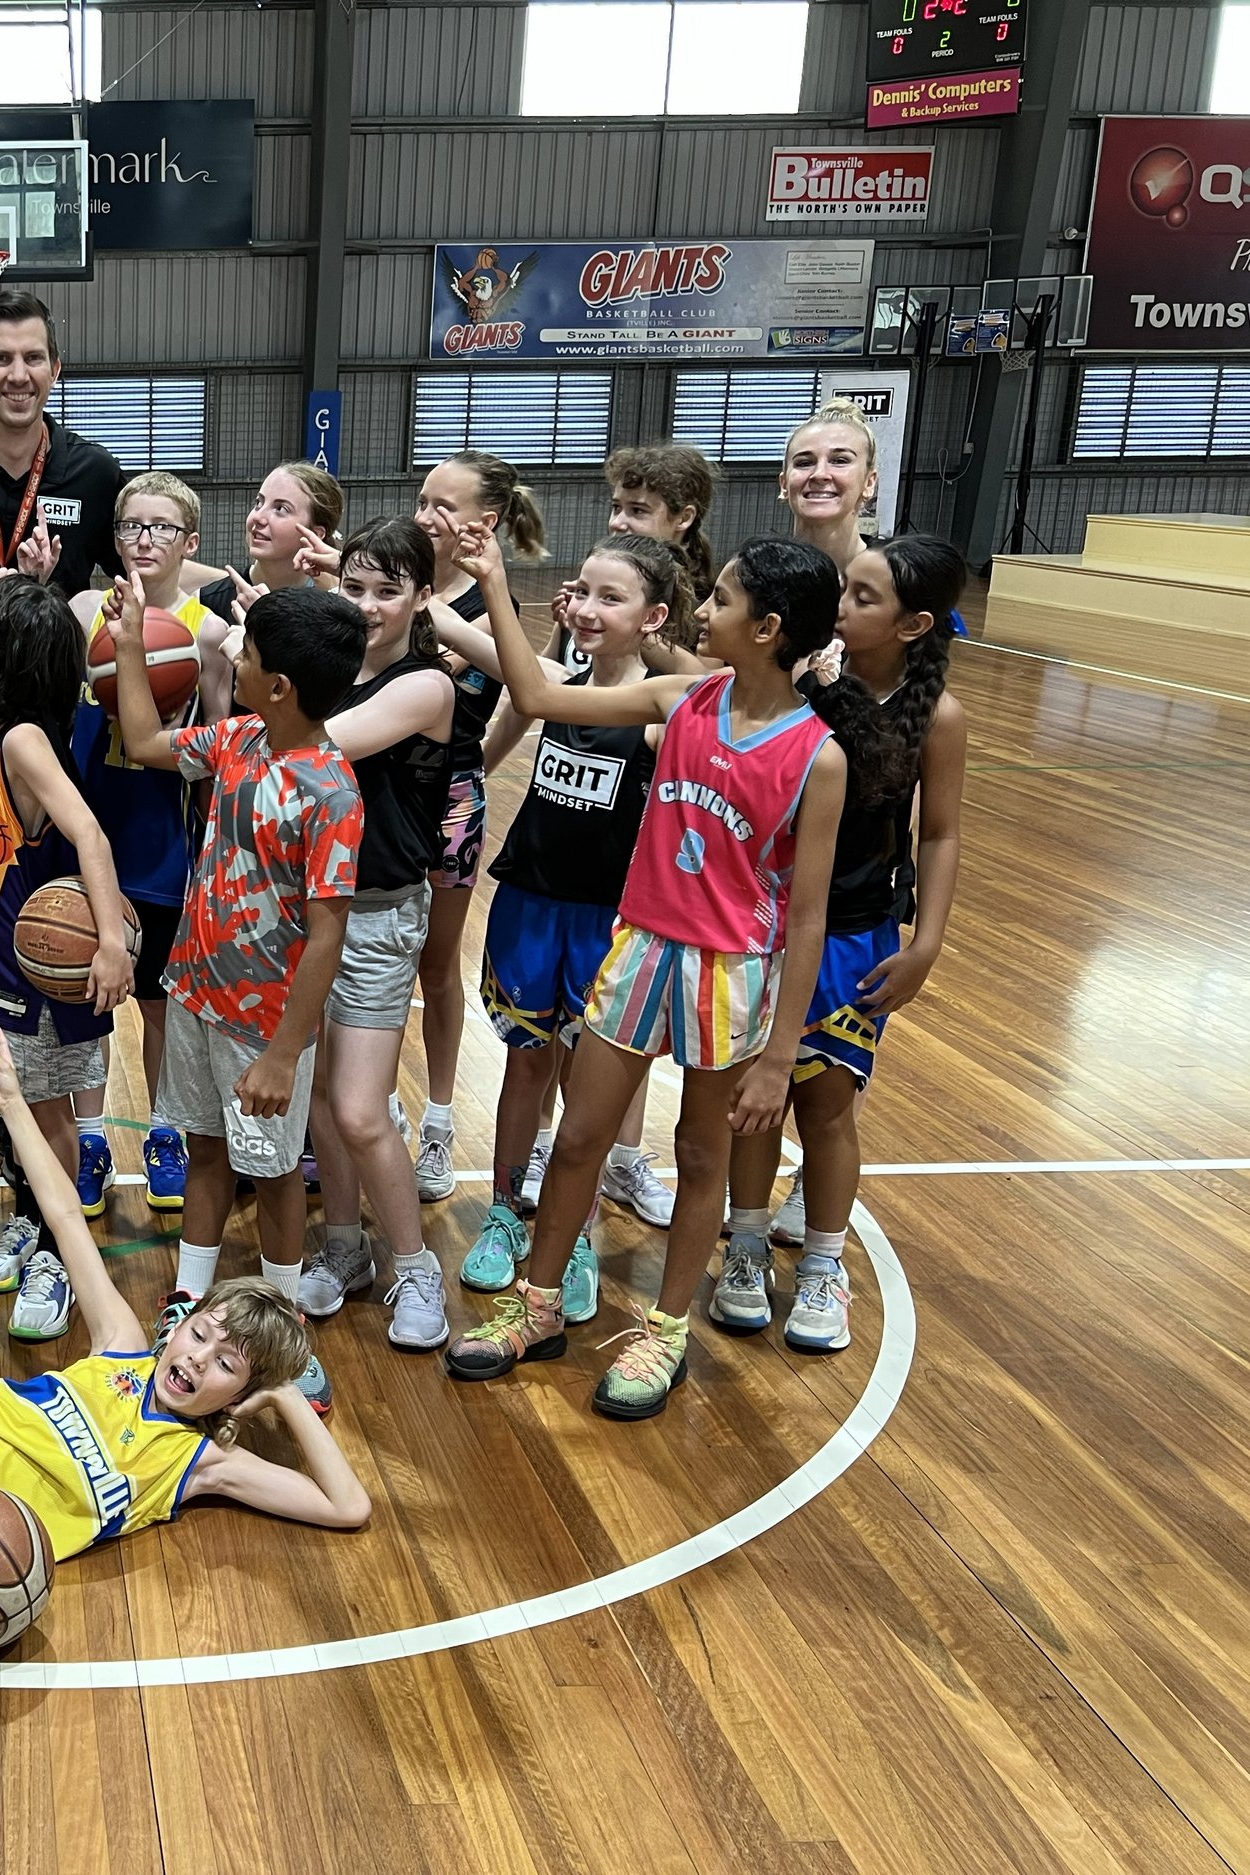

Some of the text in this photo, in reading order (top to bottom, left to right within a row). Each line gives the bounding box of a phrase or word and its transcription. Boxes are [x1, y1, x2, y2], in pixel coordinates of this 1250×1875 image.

[979, 13, 1018, 24] TEAM FOULS
[876, 27, 912, 38] TEAM FOULS
[940, 31, 950, 48] 2
[932, 49, 954, 58] PERIOD
[873, 79, 1011, 107] Dennis' Computers
[901, 101, 979, 118] & Backup Services
[810, 157, 863, 169] Townsville
[772, 156, 926, 200] Bulletin
[1200, 164, 1250, 209] Q
[32, 199, 110, 214] Townsille
[769, 203, 926, 214] THE NORTH'S OWN PAPER
[579, 244, 733, 308] GIANTS
[586, 309, 716, 318] BASKETBALL CLUB
[1130, 295, 1250, 328] Towns
[444, 321, 526, 356] GIANTS
[667, 330, 678, 338] A
[682, 330, 736, 338] GIANT
[794, 335, 828, 345] SIGNS
[556, 344, 744, 355] www.giantsbasketball.com
[838, 395, 886, 411] RIT
[315, 408, 330, 473] GIA
[43, 503, 75, 516] GRIT
[541, 754, 609, 792] GRIT
[538, 787, 593, 812] MINDSET
